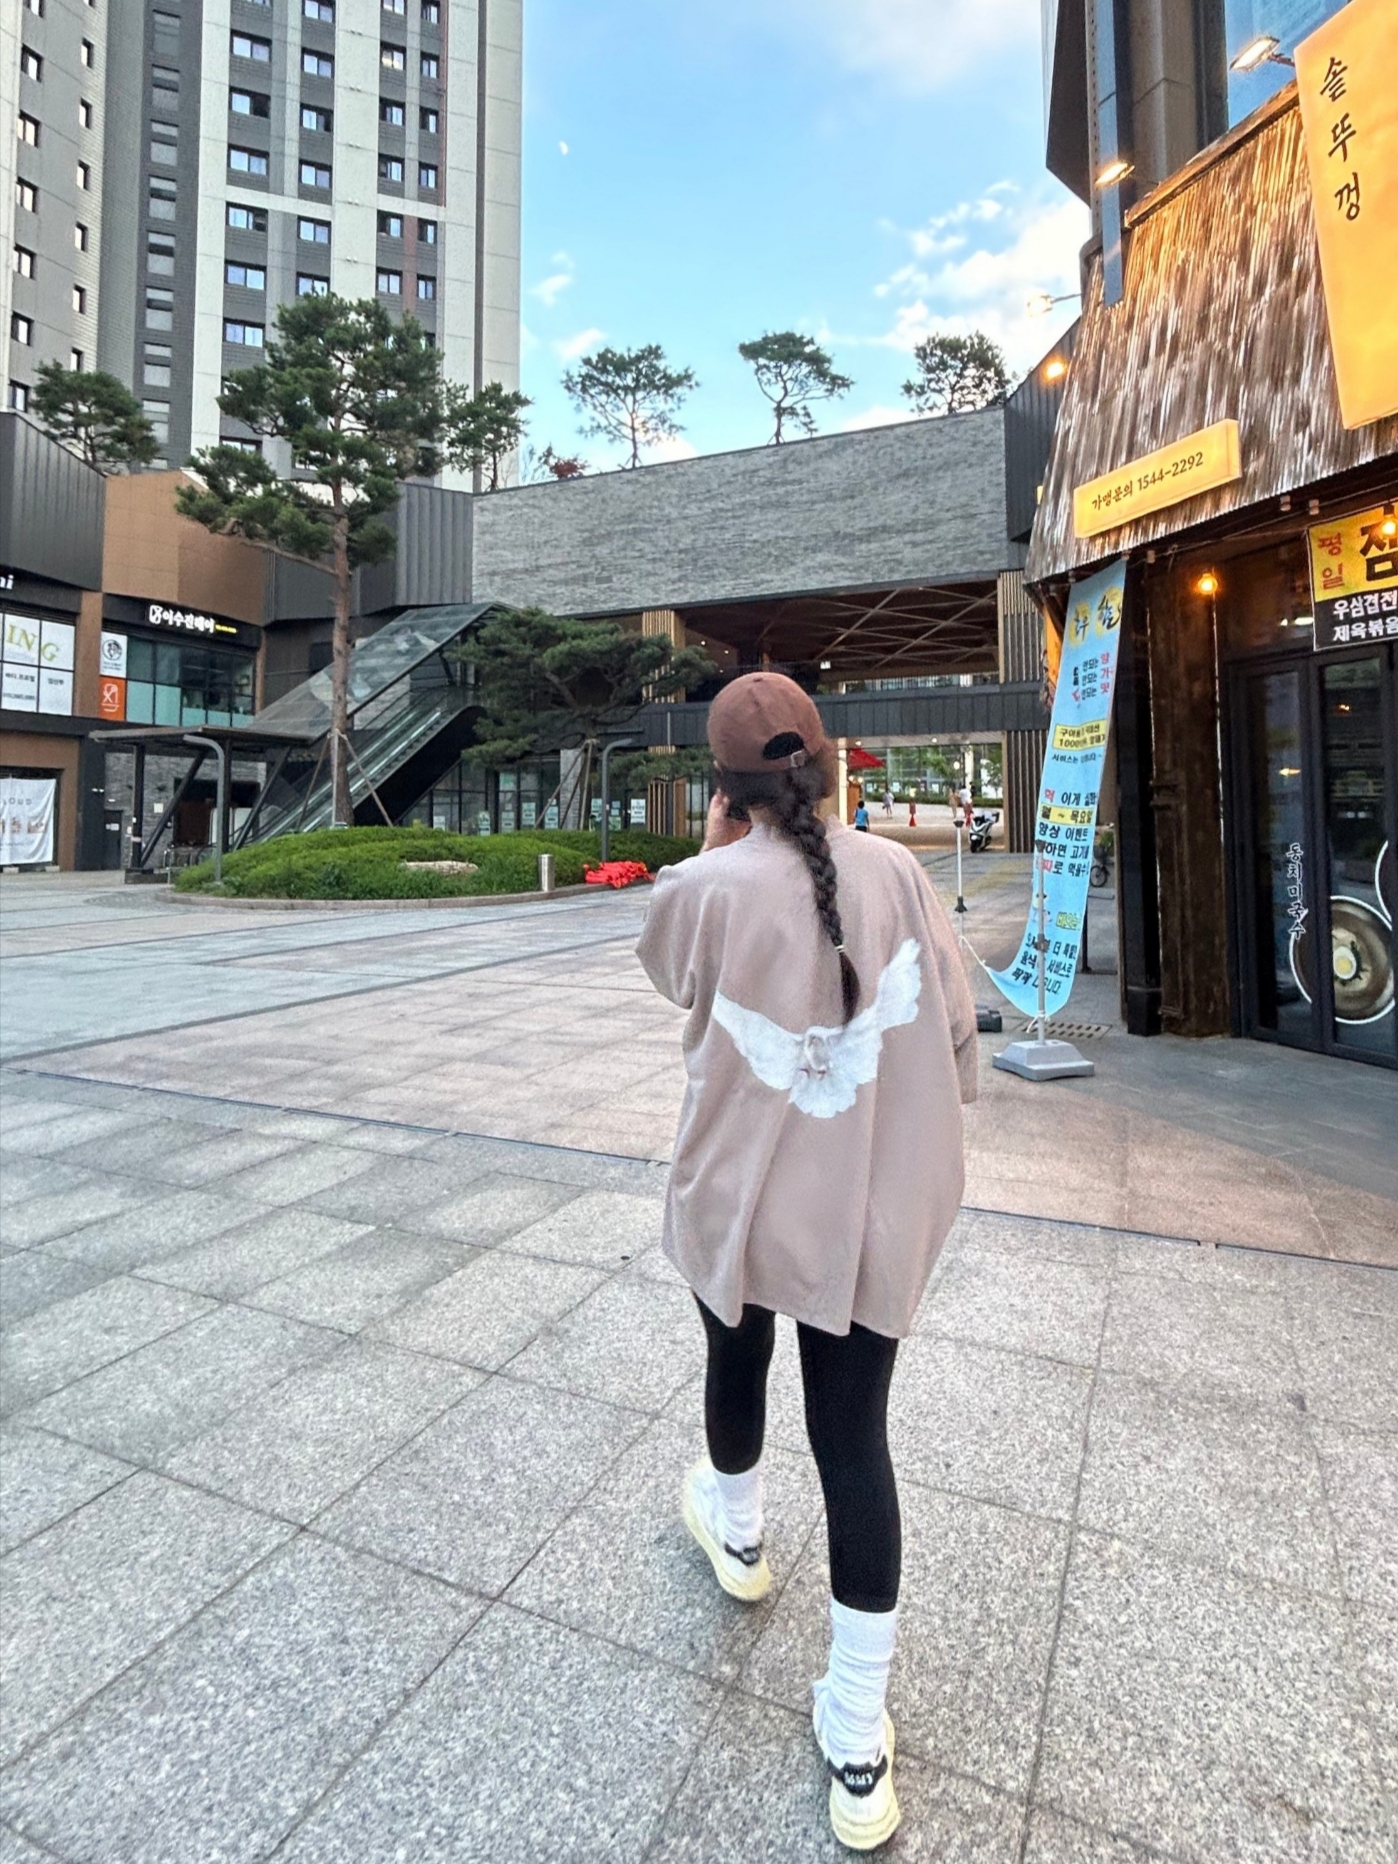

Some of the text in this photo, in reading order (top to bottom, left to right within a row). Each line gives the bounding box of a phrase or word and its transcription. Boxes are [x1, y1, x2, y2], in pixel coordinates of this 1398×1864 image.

[1091, 451, 1204, 511] 가맹문의 1544-2292
[1318, 533, 1344, 590] 평일
[1333, 590, 1398, 621] 우삼겹전
[1332, 616, 1398, 643] 제육볶음
[1061, 791, 1081, 807] 이게
[1038, 821, 1090, 842] 항상 이벤트
[1037, 840, 1068, 858] 하면
[1286, 842, 1307, 940] 동치미국수
